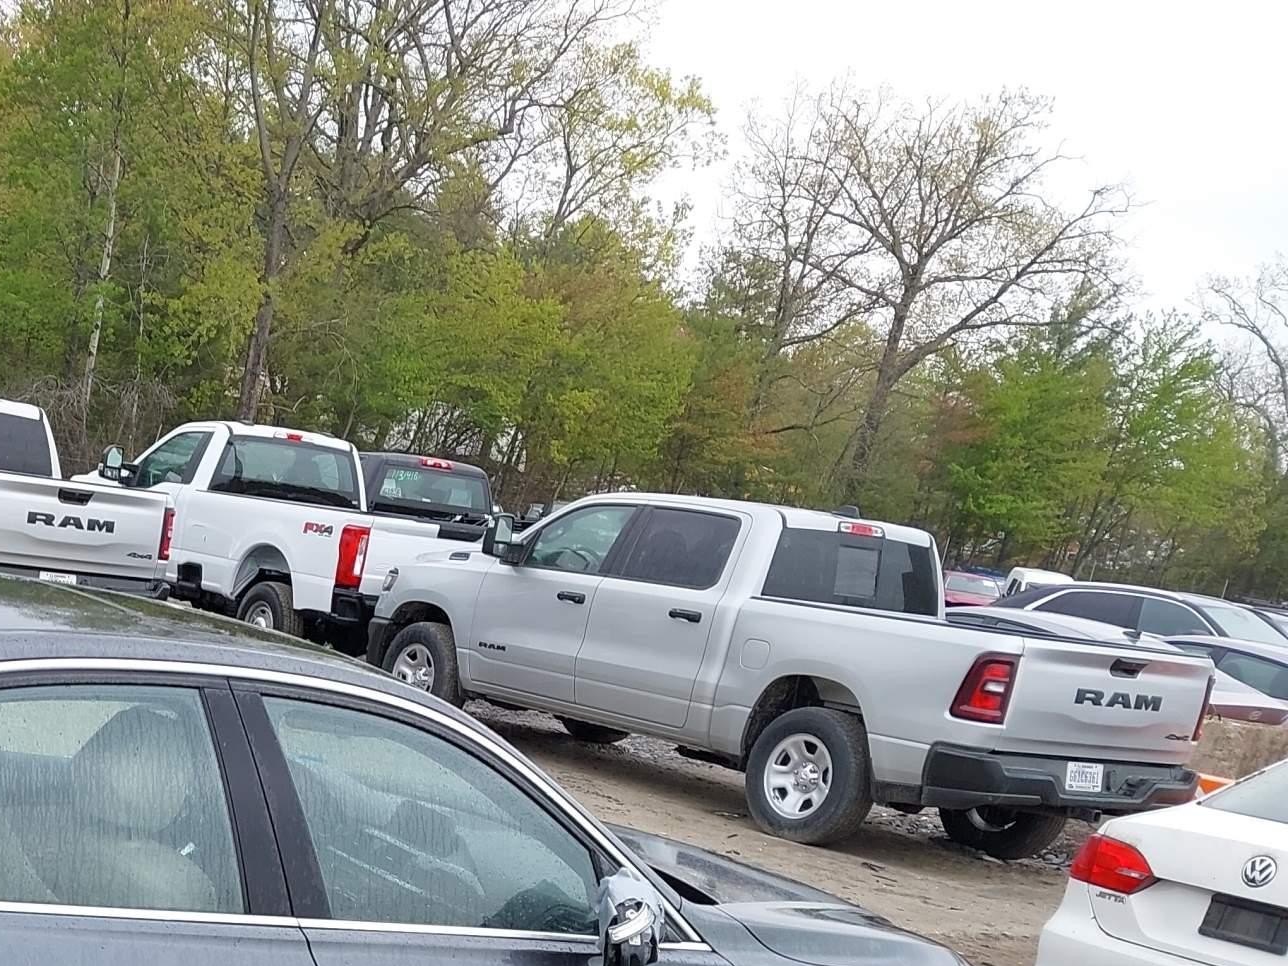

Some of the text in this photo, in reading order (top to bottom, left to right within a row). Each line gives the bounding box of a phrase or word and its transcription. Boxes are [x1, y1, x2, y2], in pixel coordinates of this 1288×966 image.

[26, 510, 116, 534] RAM
[125, 551, 153, 561] 4x4
[478, 641, 507, 652] RAM
[1074, 688, 1163, 712] RAM
